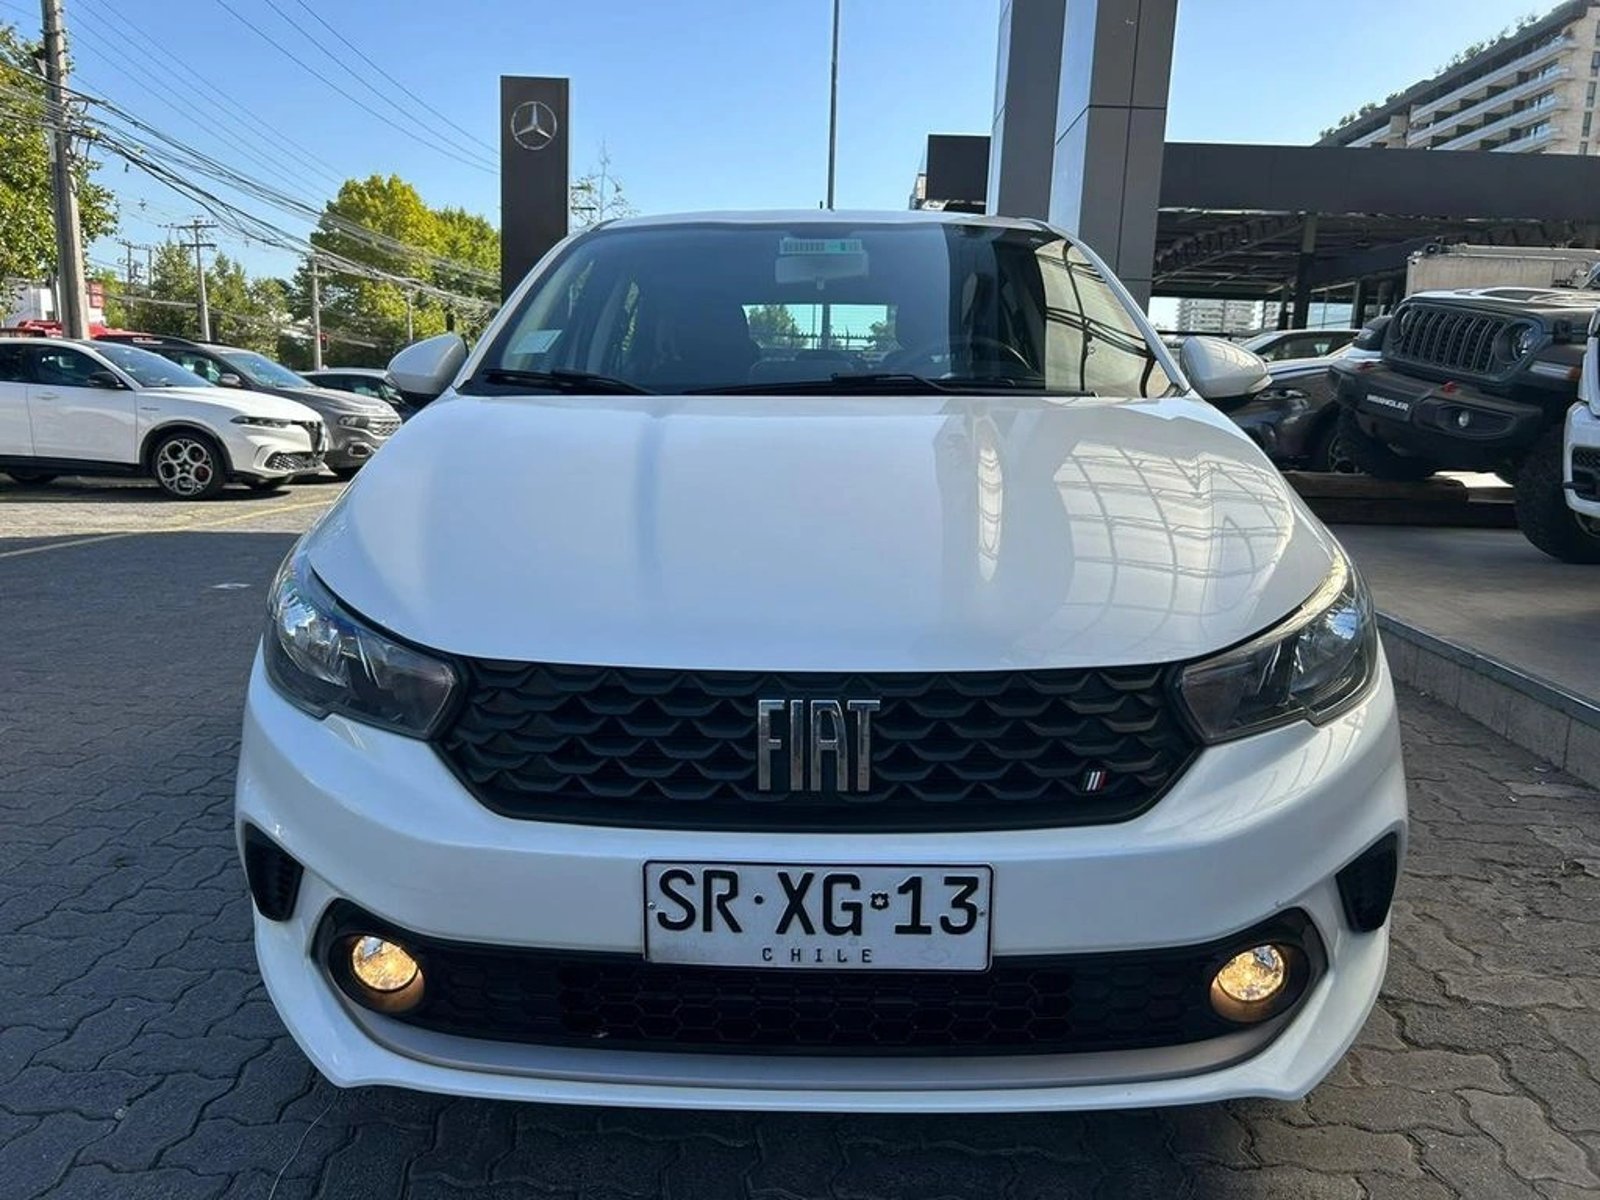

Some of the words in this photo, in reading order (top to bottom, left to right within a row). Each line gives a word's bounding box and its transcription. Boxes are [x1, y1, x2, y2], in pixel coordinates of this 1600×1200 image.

[758, 699, 880, 791] FIAT
[895, 876, 979, 936] 13
[762, 948, 873, 963] CHILE
